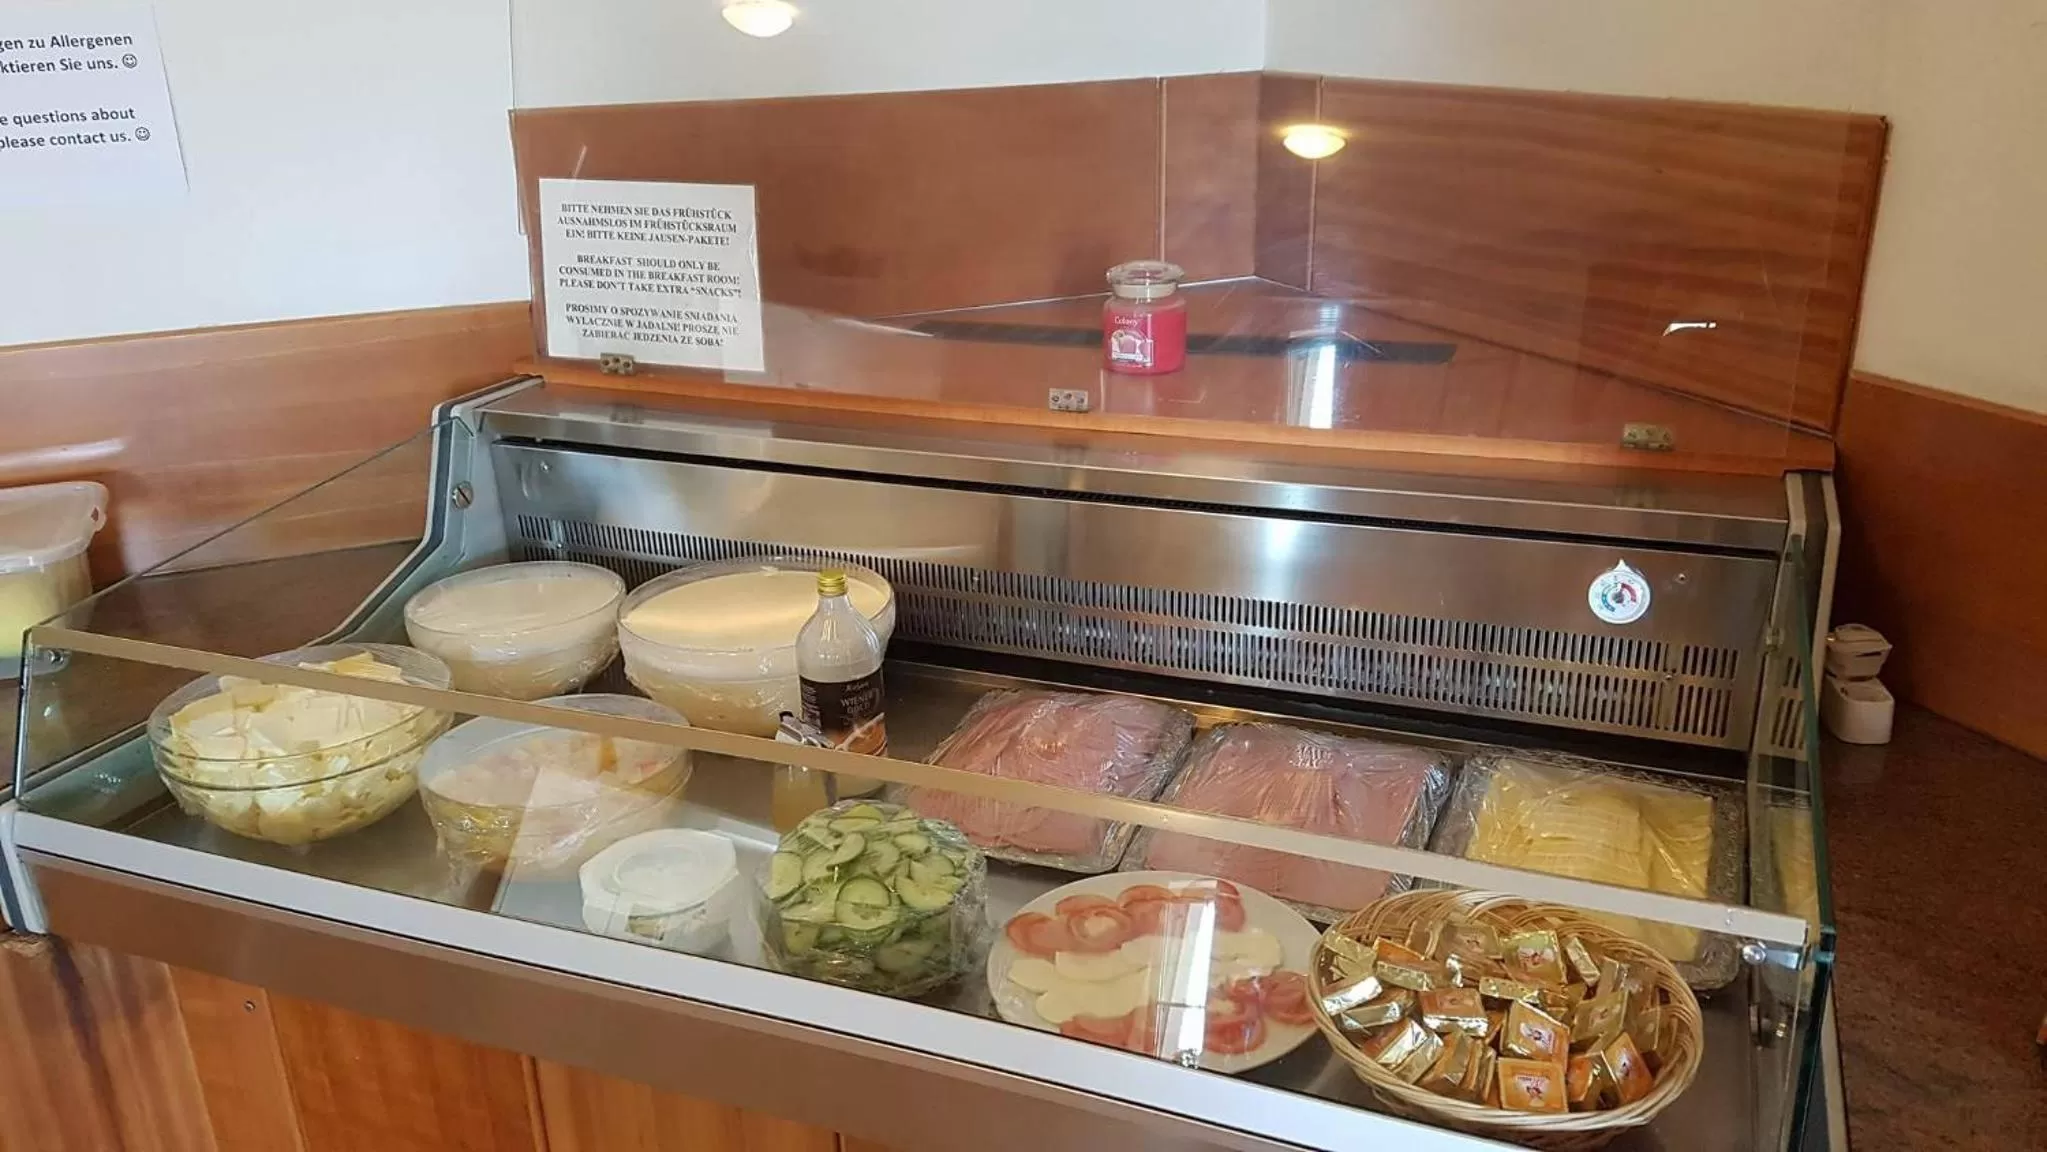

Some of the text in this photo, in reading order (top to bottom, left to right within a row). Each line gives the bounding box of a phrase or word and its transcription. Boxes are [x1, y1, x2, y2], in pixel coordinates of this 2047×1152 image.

[28, 38, 46, 49] zu
[50, 34, 133, 49] Allergenen
[59, 57, 83, 71] Sie
[86, 57, 118, 70] uns.
[13, 110, 87, 128] questions
[91, 107, 136, 122] about
[49, 132, 107, 147] contact
[109, 131, 132, 143] us.
[561, 204, 732, 220] BITTE NEHMEN SIE DAS FRÜHSTÜCK
[558, 216, 736, 233] AUSNAHMSLOS IM FRÜHSTÜCKSRAUM
[566, 229, 729, 245] EIN! BITTE KEINE JAUSEN-PAKETE!
[577, 255, 720, 271] BREAKFAST SHOULD ONLY BE
[559, 266, 740, 285] CONSUMED IN THE BREAKFAST ROOM!
[559, 278, 595, 289] PLEASE
[597, 280, 625, 290] DON'T
[629, 282, 655, 293] TAKE
[657, 284, 689, 294] EXTRA
[566, 303, 608, 314] PROSIMY
[610, 306, 618, 315] O
[625, 319, 634, 328] W
[722, 326, 737, 335] NIE
[633, 332, 678, 344] JEDZENIA
[680, 336, 693, 344] ZE
